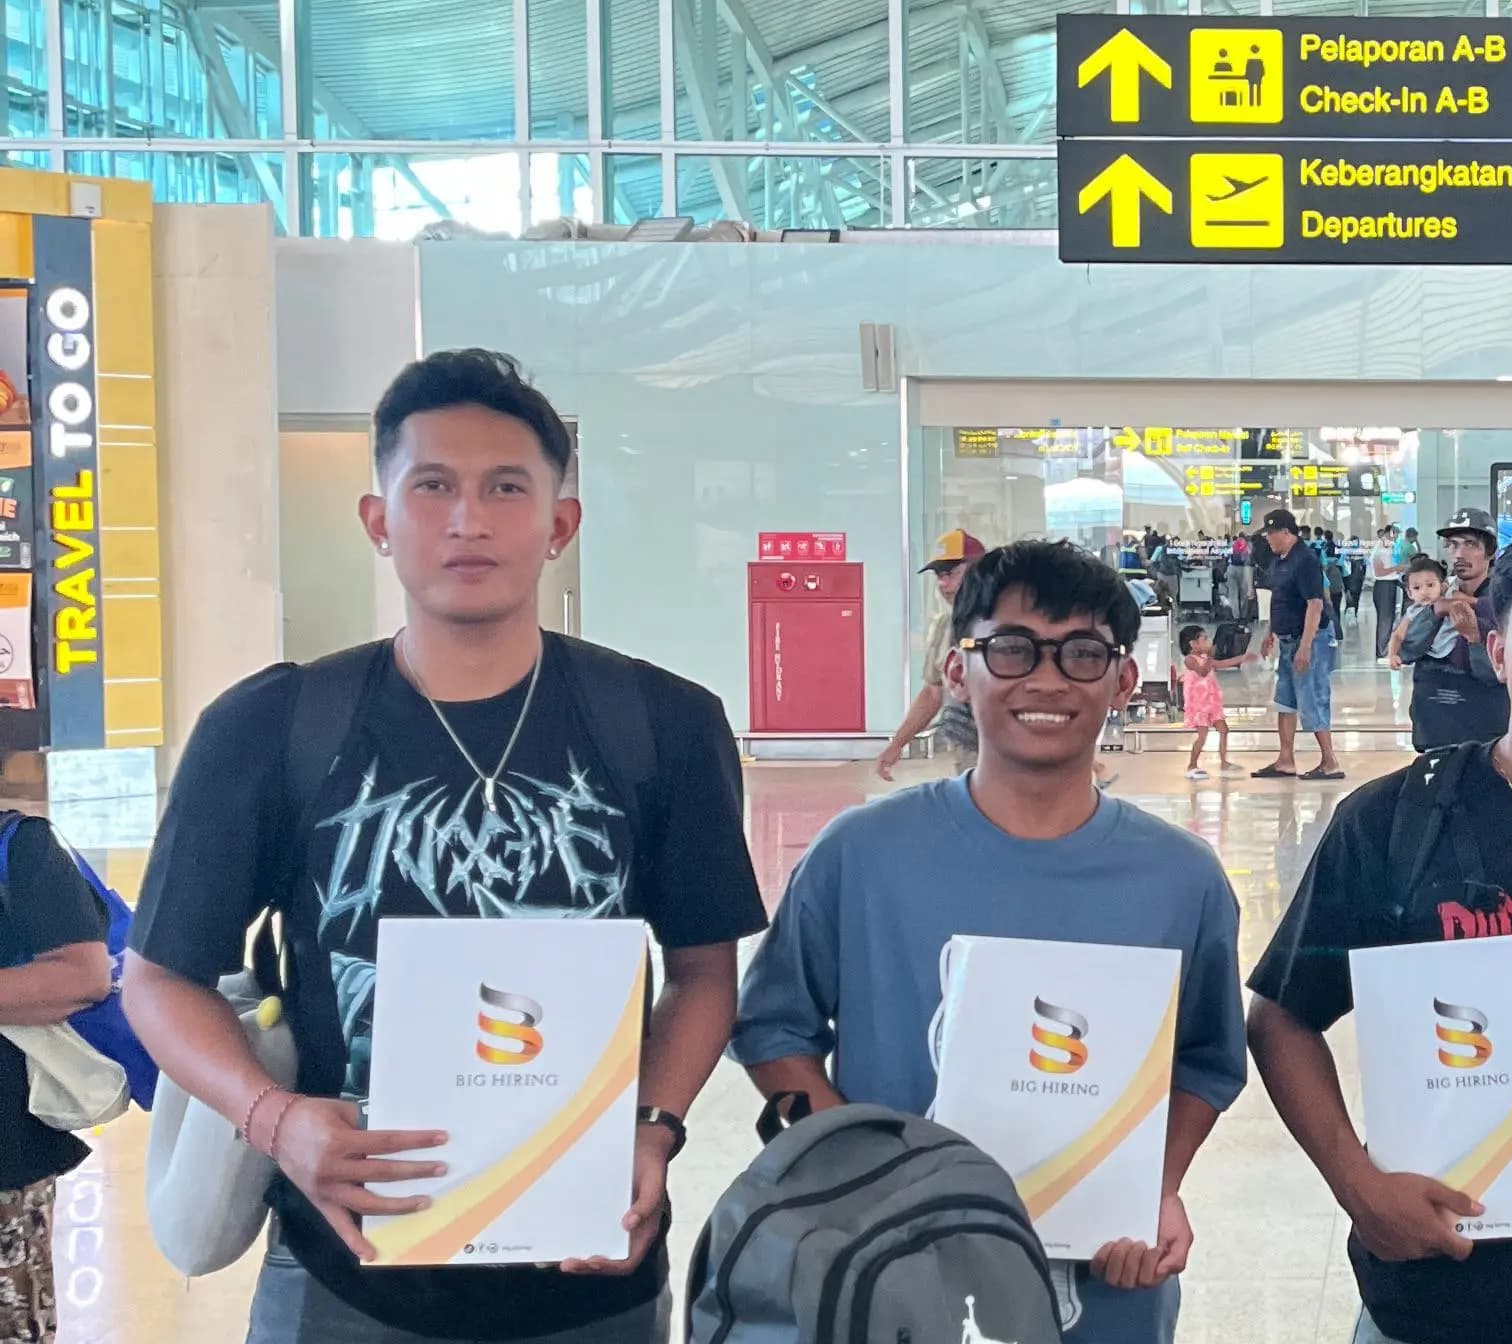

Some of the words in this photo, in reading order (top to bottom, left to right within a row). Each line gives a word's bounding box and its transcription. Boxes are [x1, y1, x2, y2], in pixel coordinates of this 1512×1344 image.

[1300, 34, 1444, 67] Pelaporan
[1452, 35, 1506, 62] A-B
[1300, 85, 1427, 113] Check-In
[1435, 86, 1489, 113] A-B
[1301, 211, 1457, 244] Departures
[46, 287, 91, 370] GO
[49, 382, 93, 457] TO
[51, 469, 97, 674] TRAVEL
[456, 1073, 486, 1088] BIG
[491, 1073, 559, 1088] HIRING
[1010, 1079, 1037, 1094] BIG
[1042, 1081, 1100, 1097] HIRING
[1426, 1076, 1452, 1090] BIG
[1455, 1073, 1510, 1089] HIRING
